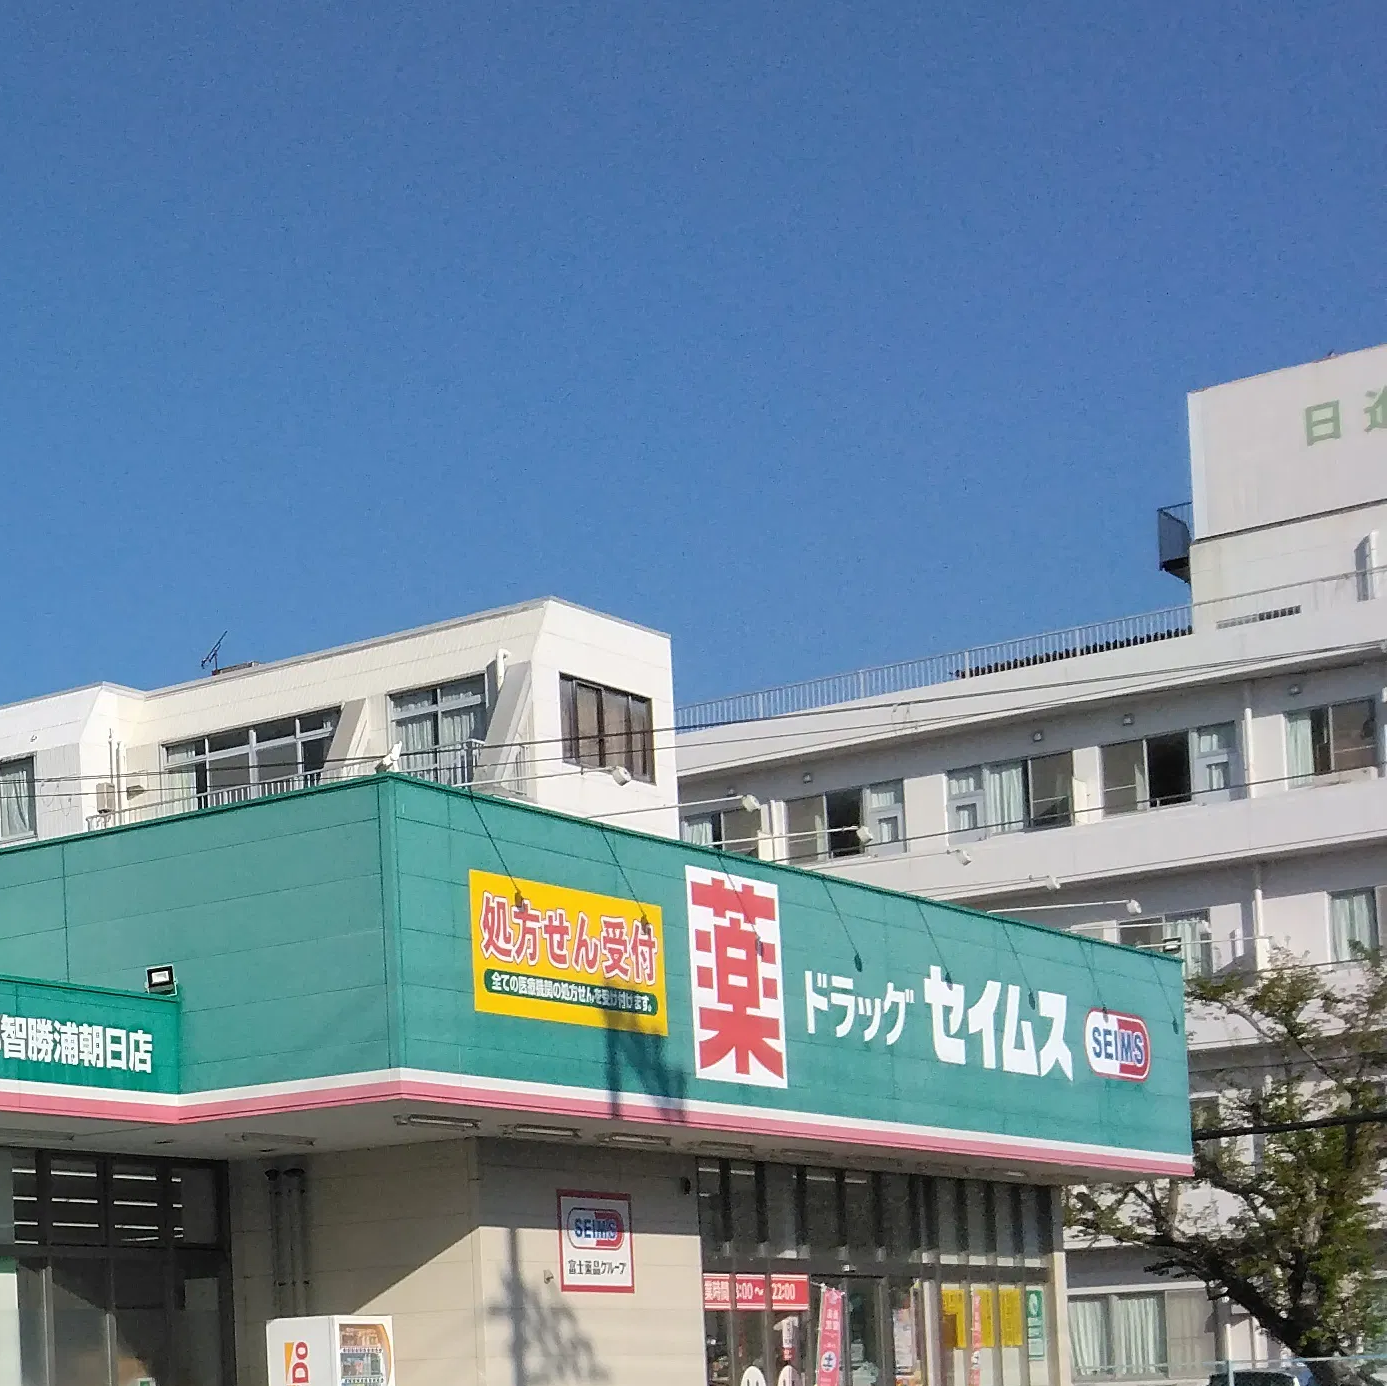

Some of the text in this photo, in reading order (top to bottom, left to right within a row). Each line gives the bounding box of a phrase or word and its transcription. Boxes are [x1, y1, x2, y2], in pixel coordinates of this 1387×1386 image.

[480, 891, 658, 986] 処方せん受付
[691, 877, 785, 1080] 薬
[804, 964, 1074, 1082] ドラッグ セイムス
[1091, 1028, 1146, 1068] SEIMS
[574, 1218, 617, 1239] SEIMS
[568, 1259, 627, 1275] 富士薬品グループ
